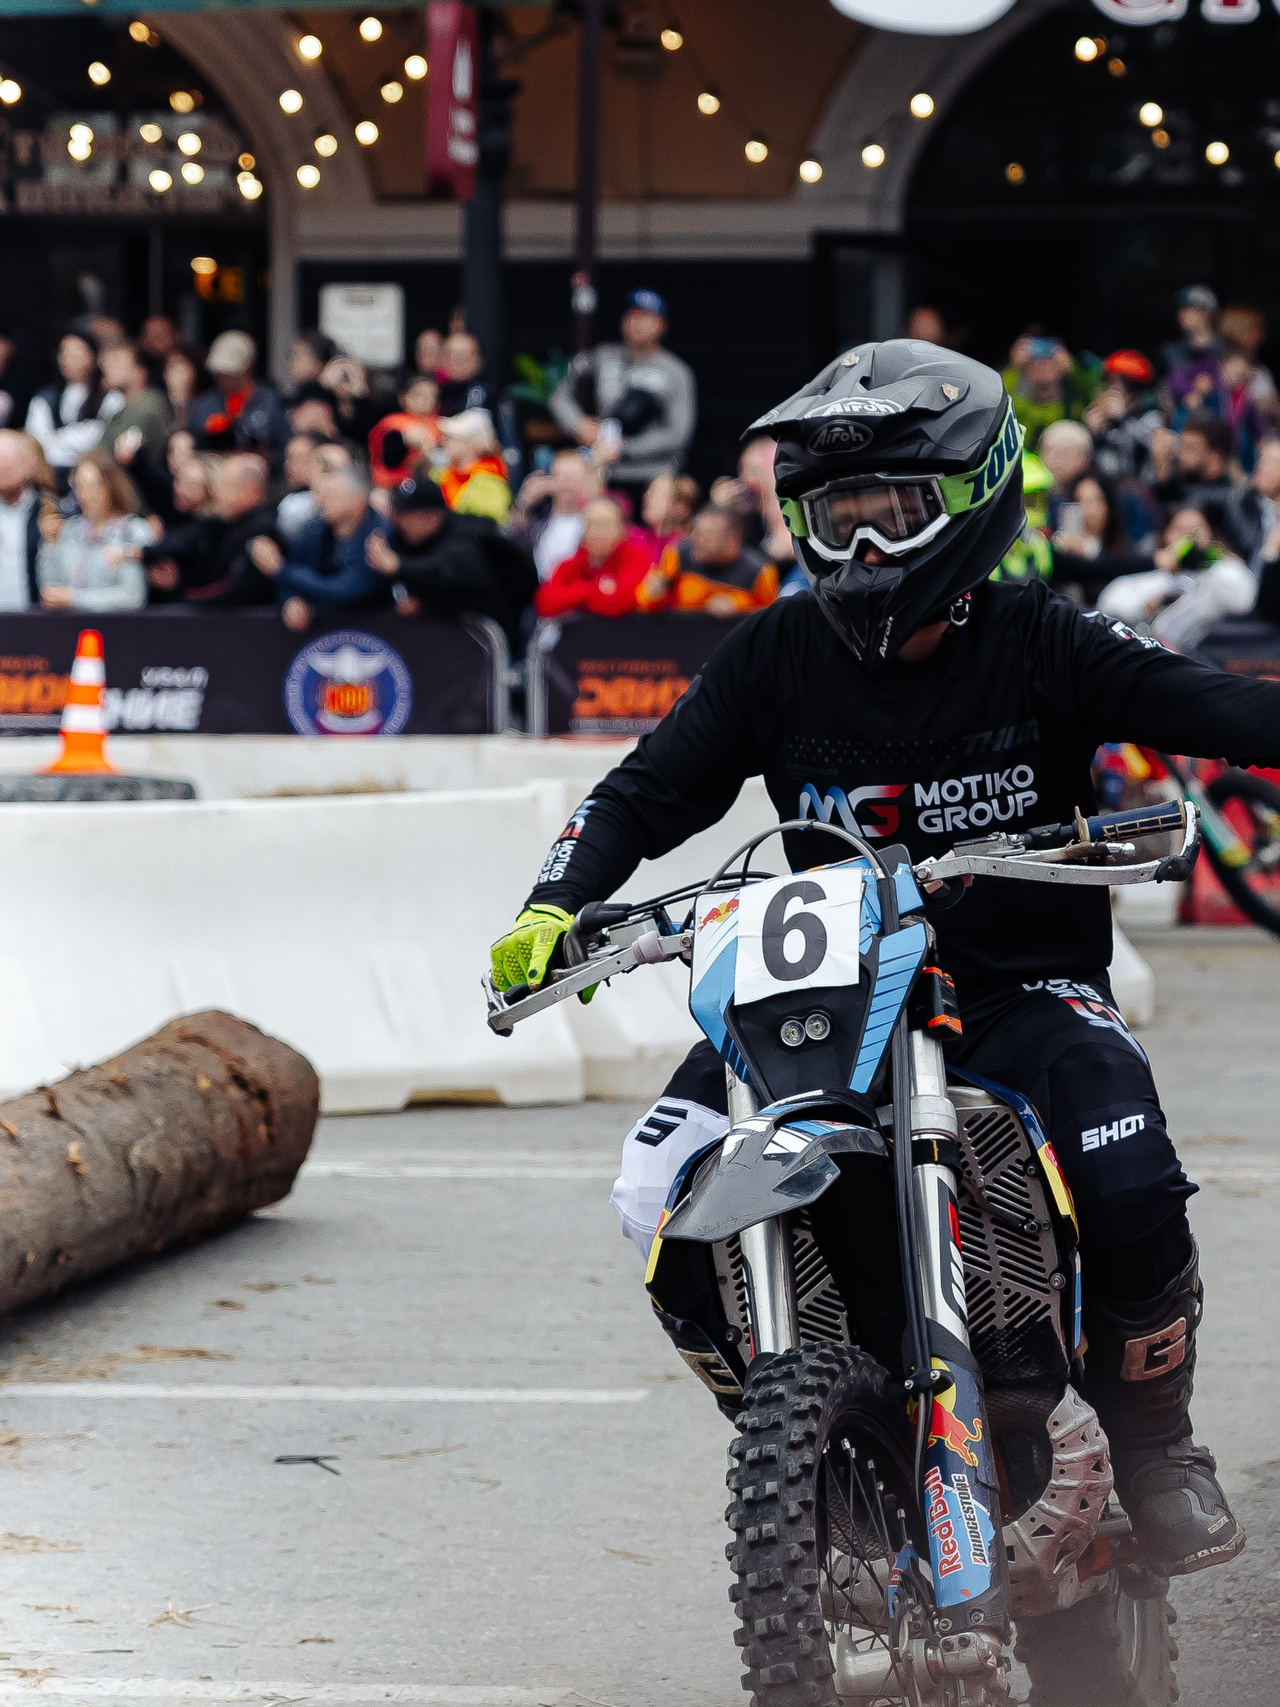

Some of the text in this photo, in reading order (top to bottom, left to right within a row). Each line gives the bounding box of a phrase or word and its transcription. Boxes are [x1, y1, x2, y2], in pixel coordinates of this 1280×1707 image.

[823, 401, 896, 416] Airoh
[813, 425, 864, 449] Airoh
[962, 718, 1042, 757] THOR
[913, 764, 1035, 807] MOTIKO
[917, 790, 1039, 833] GROUP
[762, 880, 828, 982] 6
[1081, 1113, 1145, 1152] SHOT
[924, 1465, 963, 1579] Red Bull
[951, 1473, 990, 1567] BRIDGESTONE
